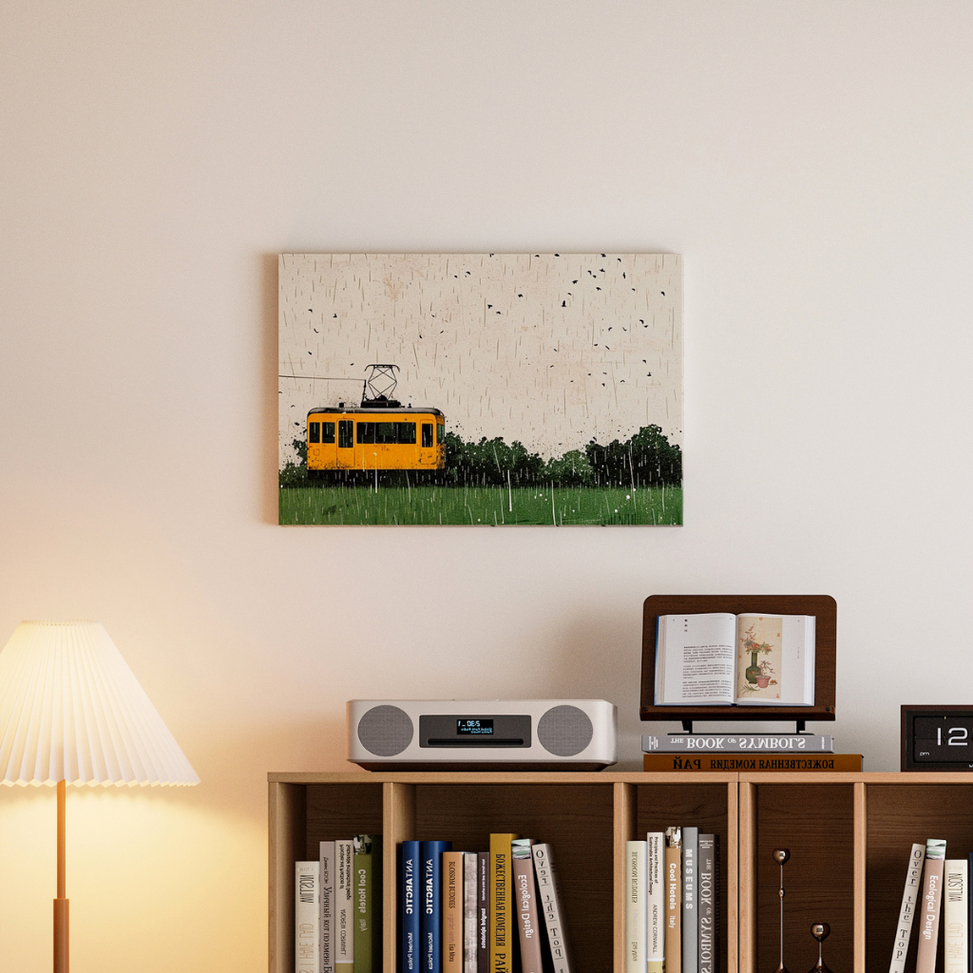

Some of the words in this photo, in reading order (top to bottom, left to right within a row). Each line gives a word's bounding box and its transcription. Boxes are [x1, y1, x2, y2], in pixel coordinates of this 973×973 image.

[937, 727, 968, 746] 12
[910, 850, 922, 884] Over
[496, 854, 505, 910] БОЖЕСТВЕННАЯ
[925, 875, 938, 912] Ecological
[323, 886, 332, 918] Уличный
[903, 896, 912, 921] the
[496, 911, 505, 946] КОМЕДИЯ
[668, 916, 676, 928] Italy
[922, 914, 936, 940] Design
[323, 933, 330, 942] по
[896, 930, 907, 959] Top
[495, 953, 508, 973] РАЙ
